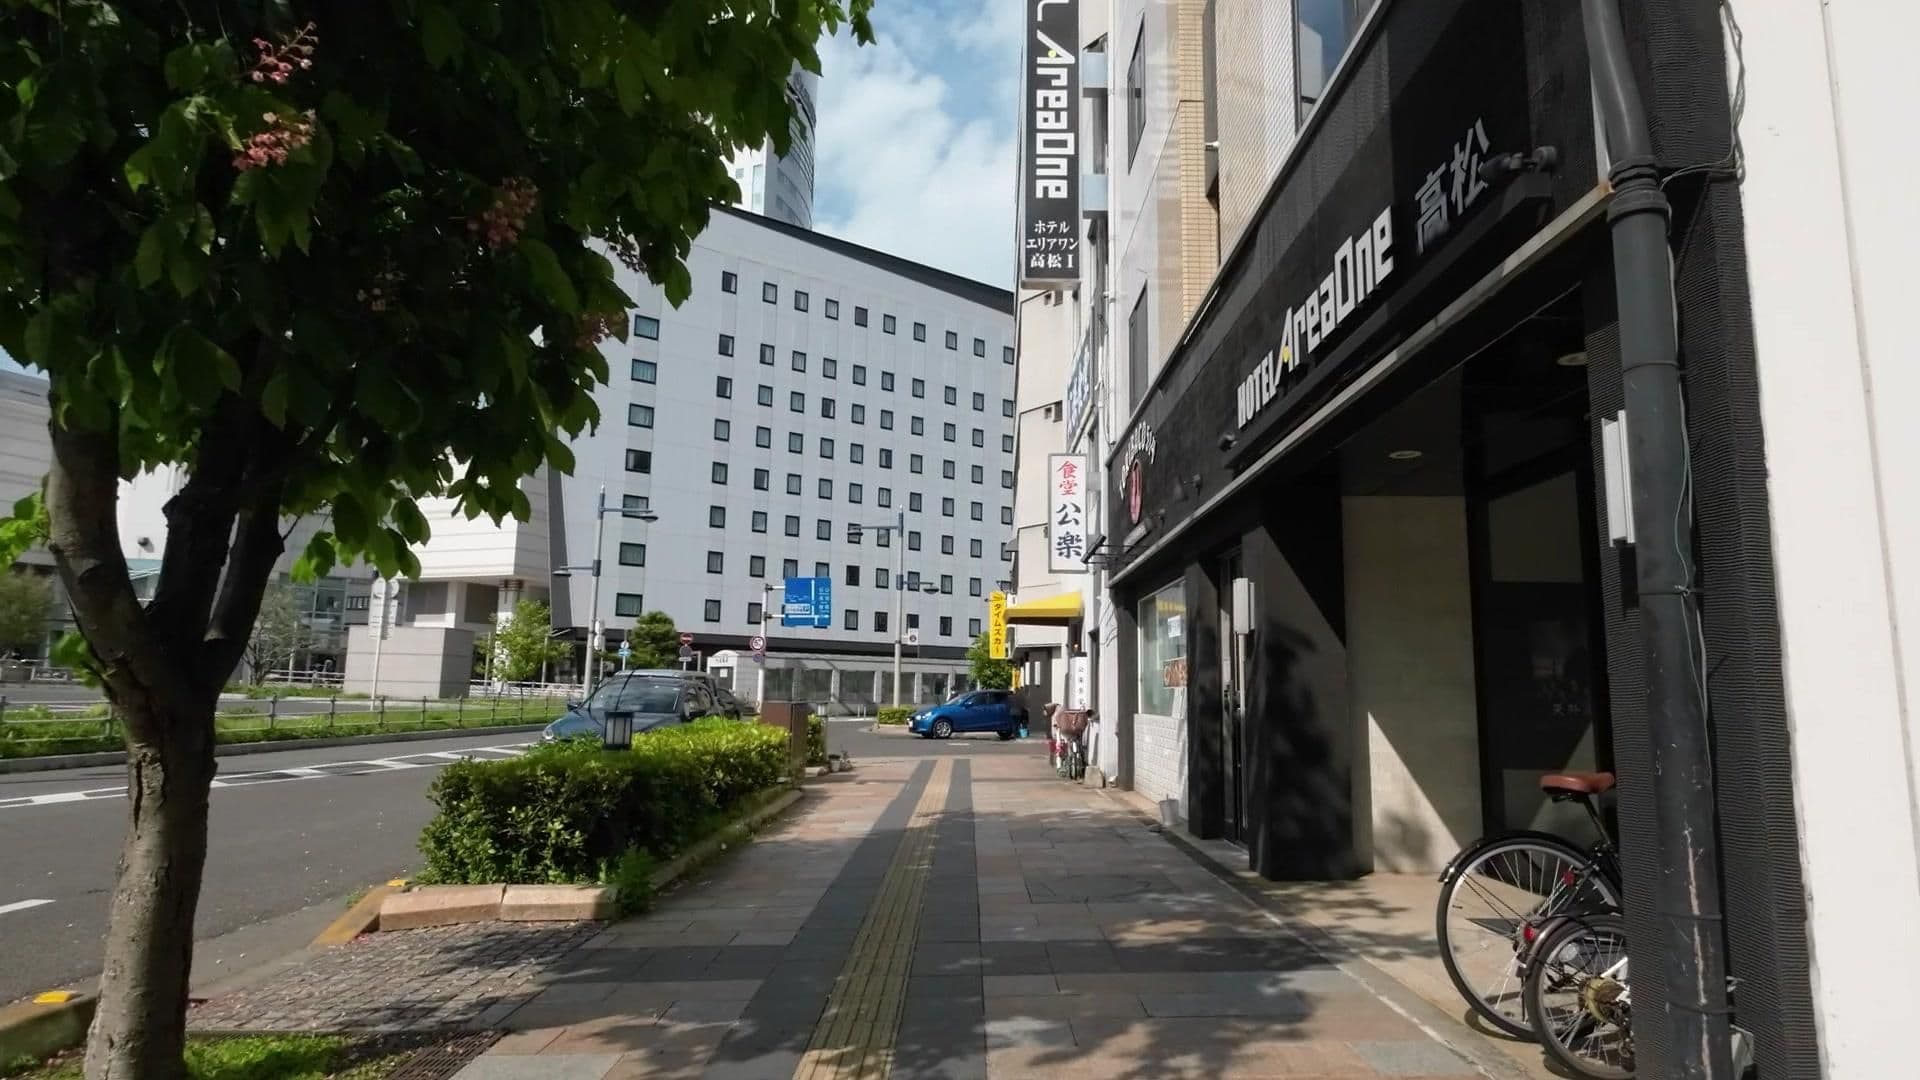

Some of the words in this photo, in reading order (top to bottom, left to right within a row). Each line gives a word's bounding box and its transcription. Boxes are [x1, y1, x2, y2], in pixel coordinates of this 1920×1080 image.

[1036, 29, 1075, 199] AreaOne
[1414, 116, 1490, 256] 高松
[1026, 236, 1079, 251] エリアワン
[1034, 219, 1070, 234] ホテル
[1237, 350, 1277, 430] HOTEL
[1274, 204, 1394, 387] AreaOne
[1057, 460, 1079, 496] 食堂
[1055, 502, 1083, 559] 公楽
